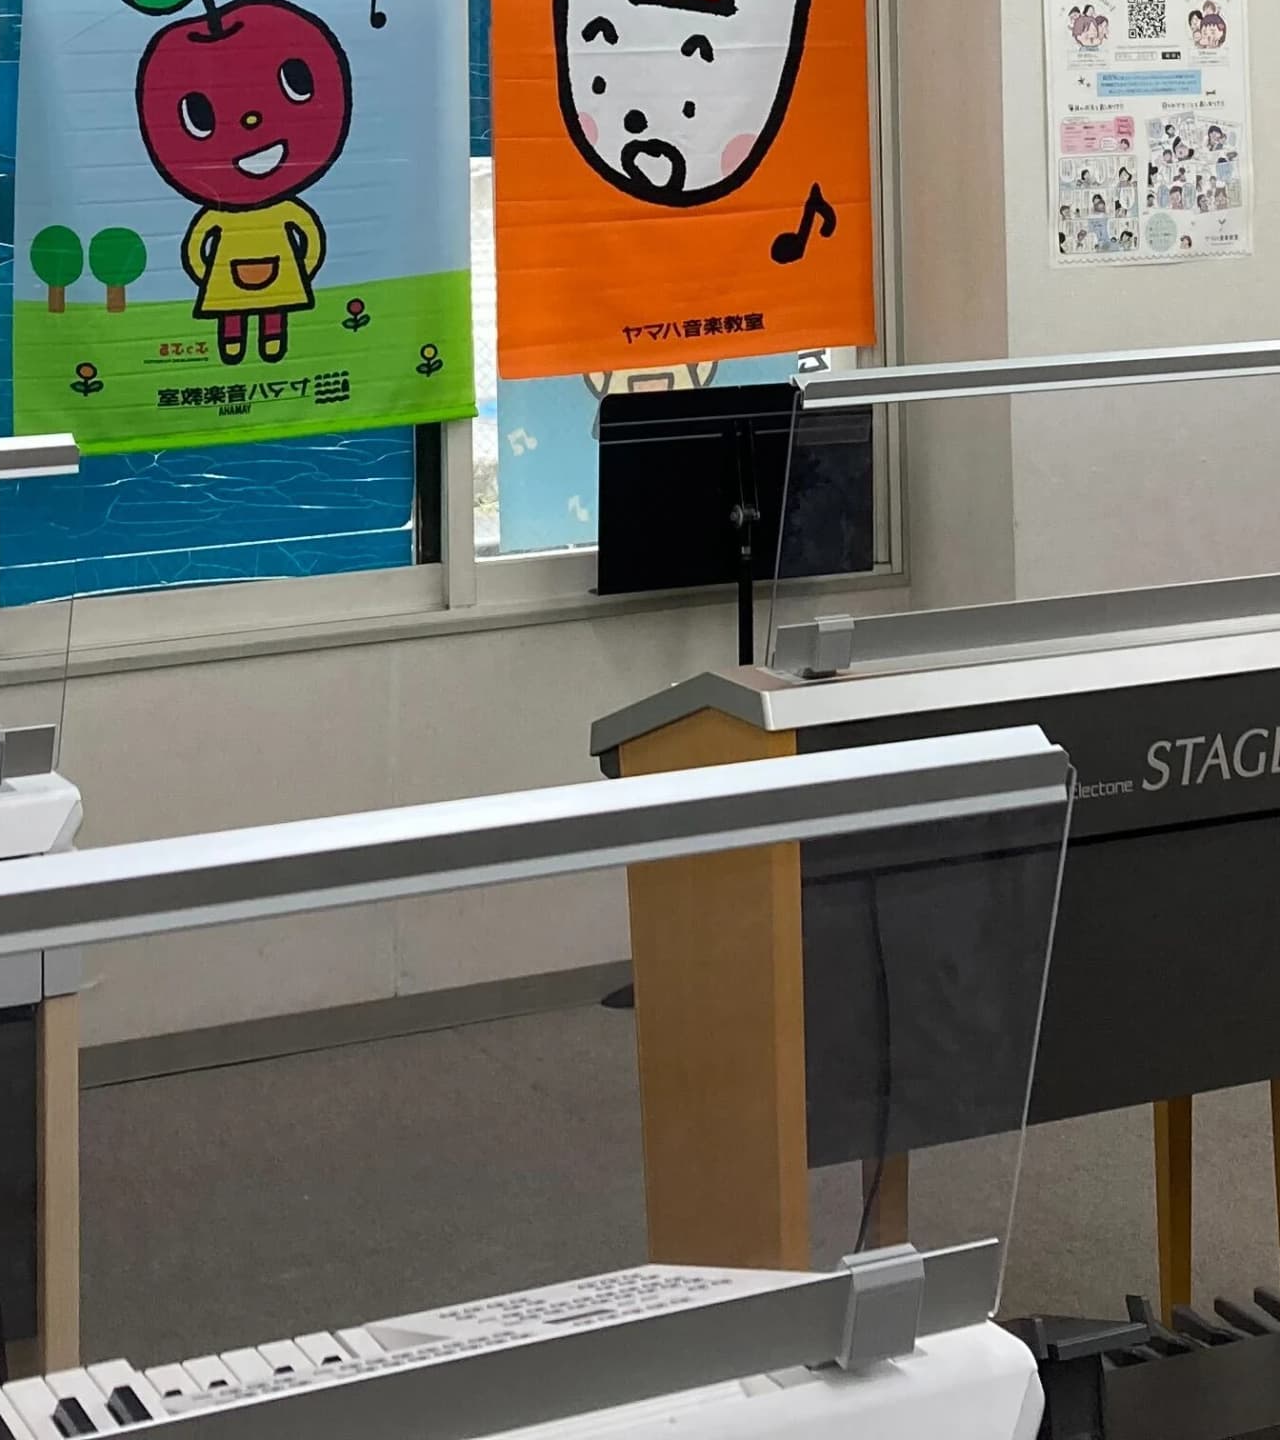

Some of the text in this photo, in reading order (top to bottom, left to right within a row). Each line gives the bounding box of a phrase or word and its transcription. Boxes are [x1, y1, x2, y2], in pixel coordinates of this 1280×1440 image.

[622, 313, 766, 344] ヤマハ音楽教室
